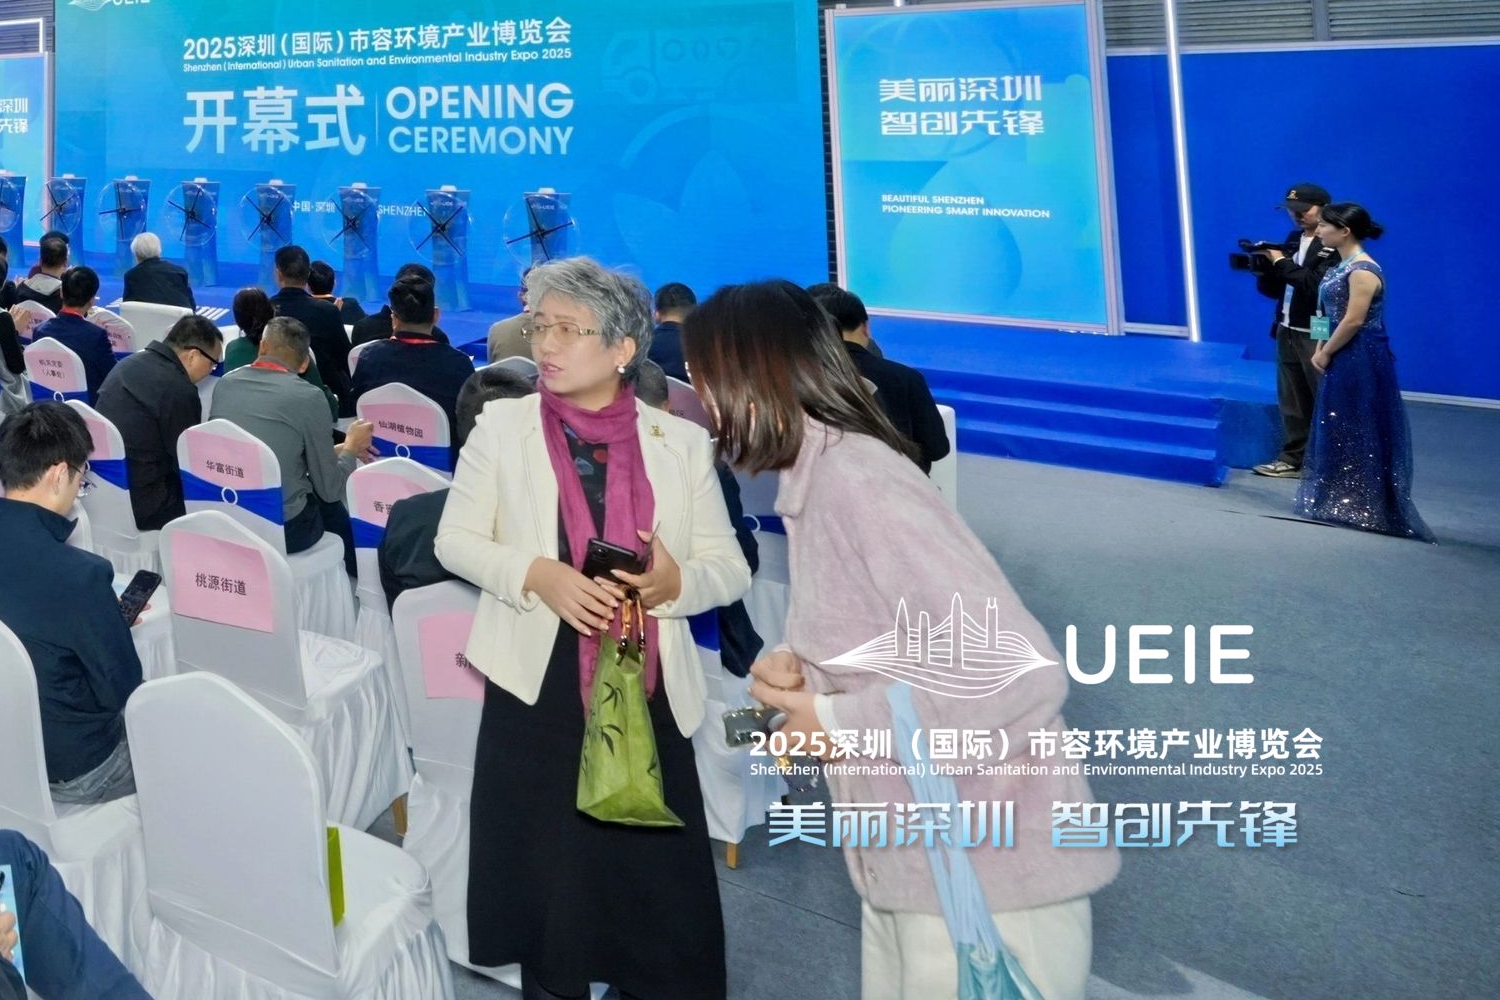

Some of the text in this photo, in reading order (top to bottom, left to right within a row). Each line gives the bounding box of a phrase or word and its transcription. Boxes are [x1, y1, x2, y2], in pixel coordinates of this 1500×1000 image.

[183, 63, 222, 73] Shenzhen
[288, 58, 315, 68] Urban
[317, 57, 364, 67] Sanitation
[367, 55, 386, 65] and
[389, 53, 462, 65] Environmental
[465, 50, 508, 63] Industry
[511, 49, 539, 61] Expo
[542, 48, 572, 59] 2025
[386, 82, 575, 120] OPENING
[879, 75, 1042, 103] 美丽深圳
[183, 84, 366, 156] 开幕式
[880, 110, 1045, 136] 智创先锋
[388, 126, 575, 155] CEREMONY
[882, 194, 985, 205] BEAUTIFUL SHENZHEN
[882, 205, 1050, 218] PIONEERING SMART INNOVATION
[379, 420, 424, 438] 仙湖植物园
[205, 459, 244, 478] 华富街道
[195, 572, 247, 596] 桃源街道
